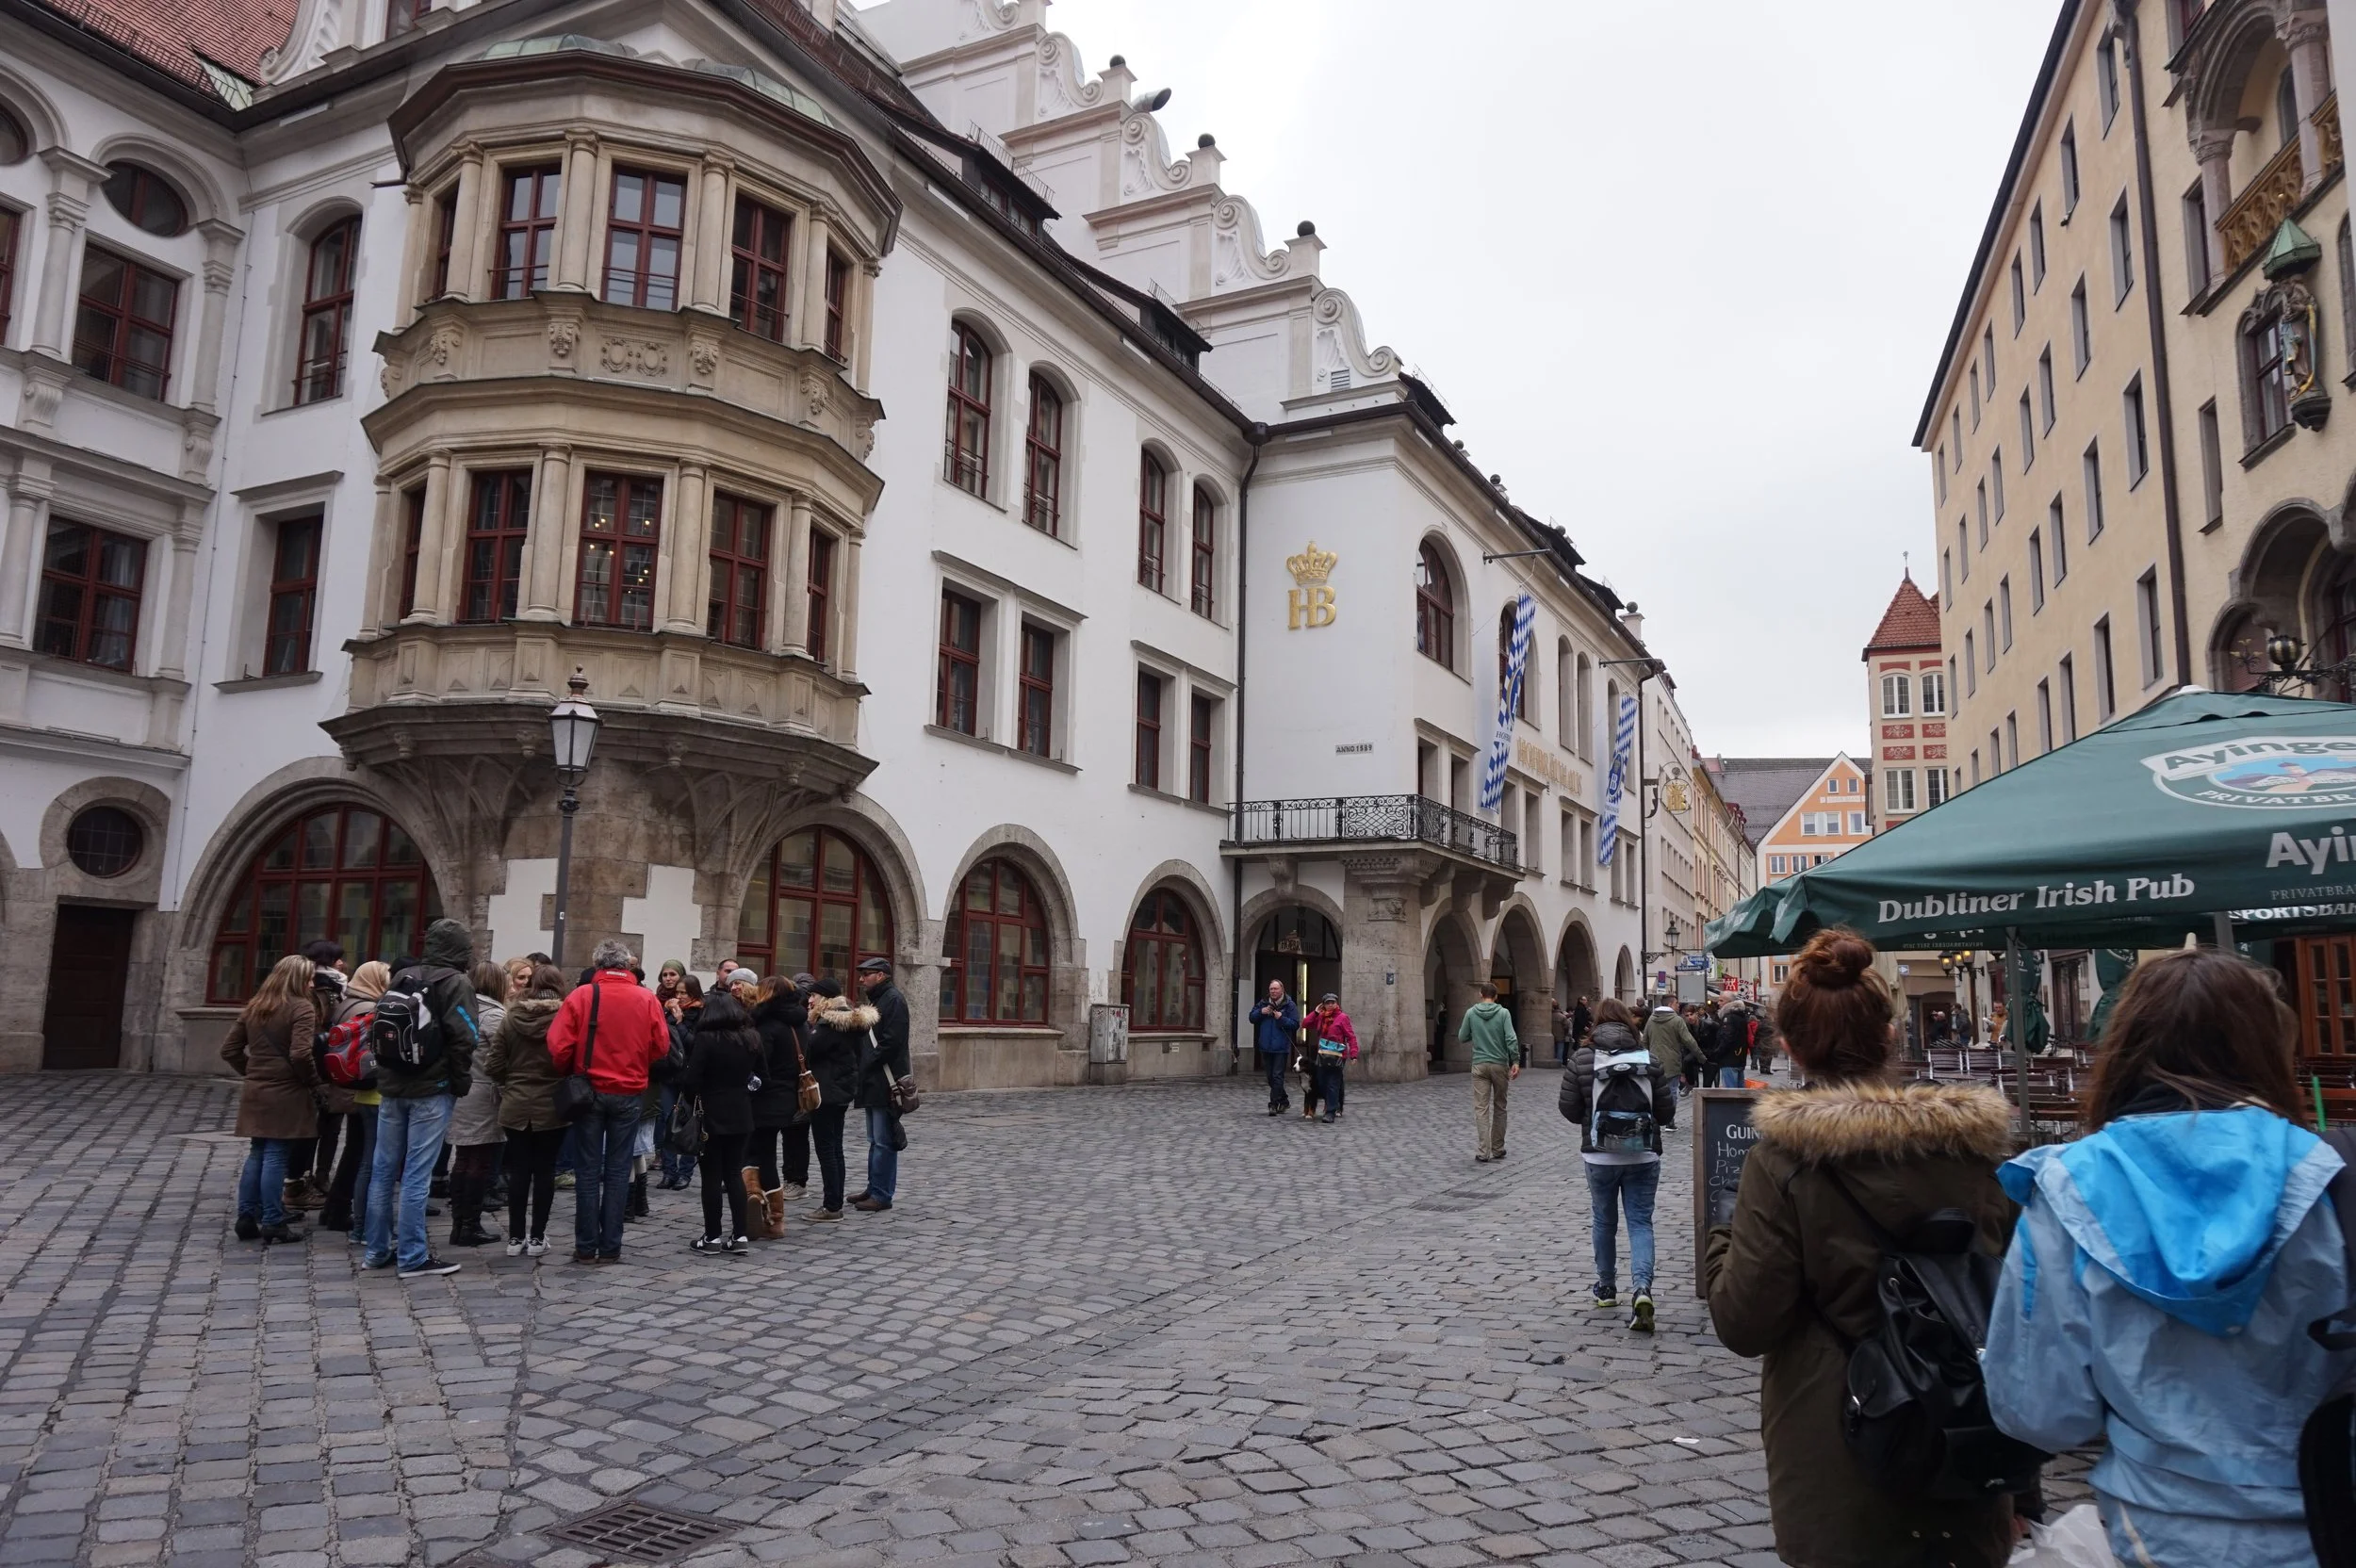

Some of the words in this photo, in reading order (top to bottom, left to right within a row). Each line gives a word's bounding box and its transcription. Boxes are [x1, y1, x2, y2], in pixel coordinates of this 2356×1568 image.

[1287, 585, 1336, 629] HB
[1335, 744, 1355, 753] ANNO
[1877, 891, 2025, 923] Dubliner
[2035, 879, 2118, 908] Irish
[2126, 873, 2195, 902] Pub
[2270, 884, 2356, 901] PRIVATBRA
